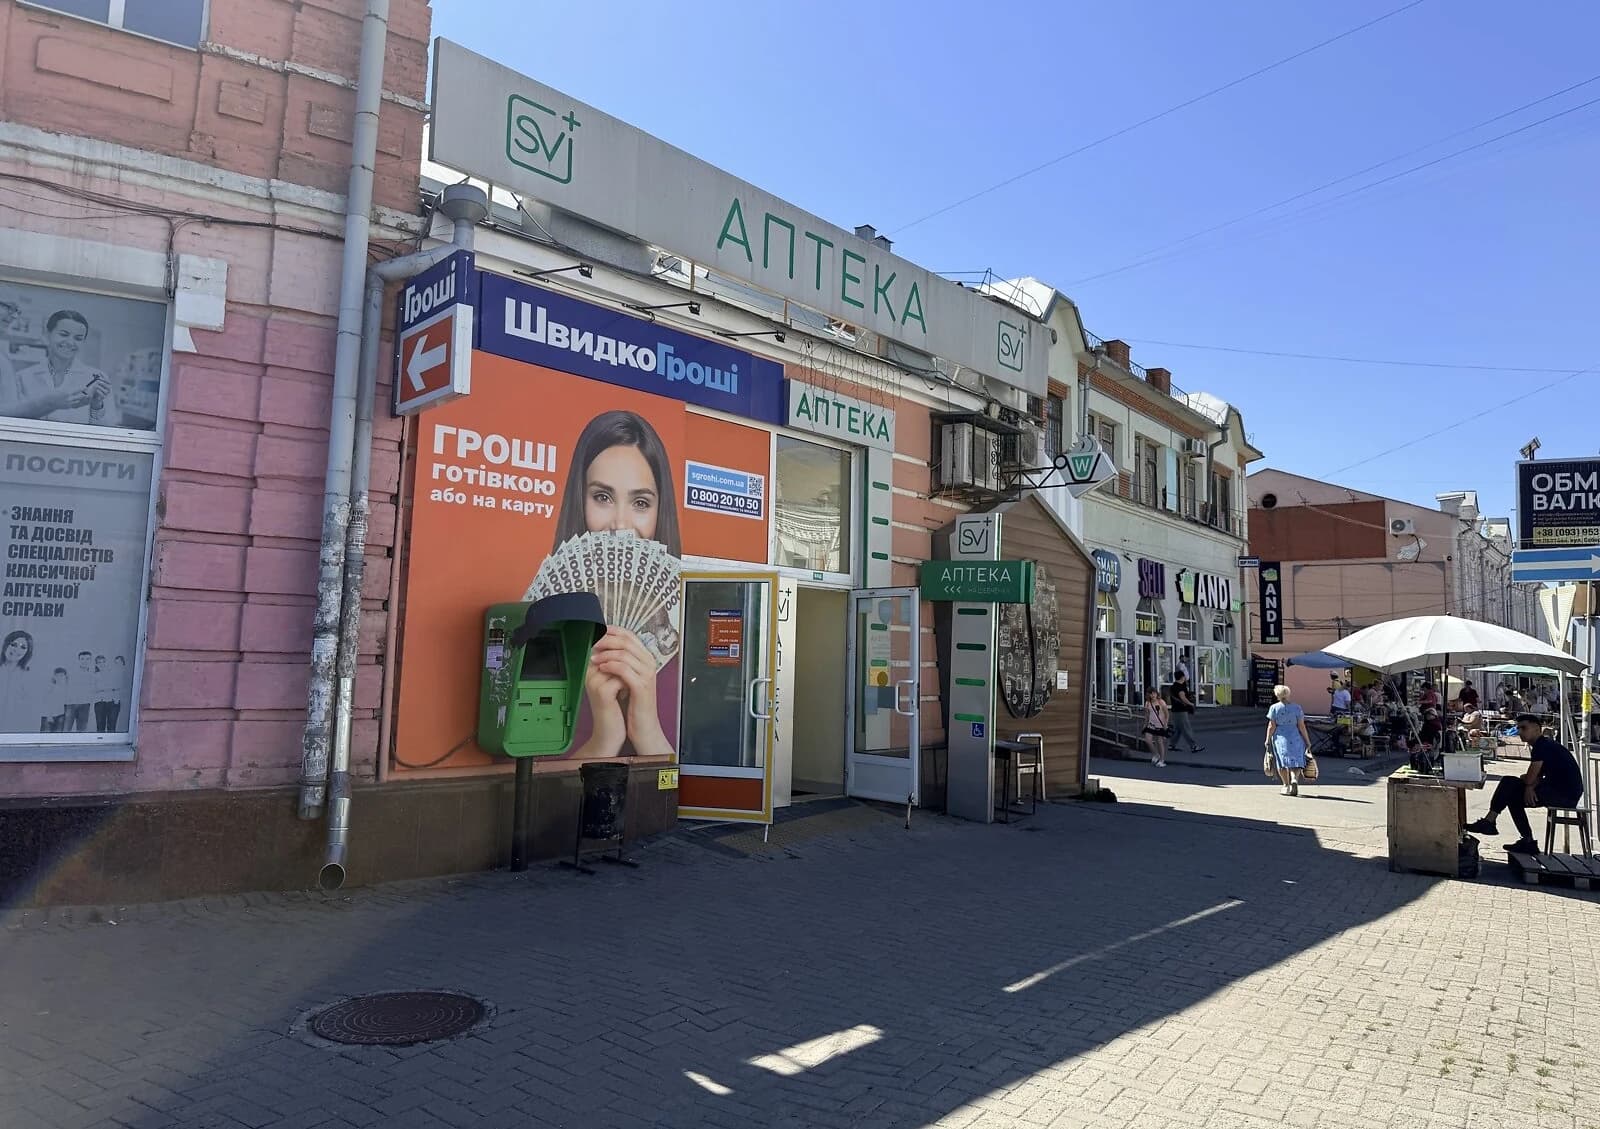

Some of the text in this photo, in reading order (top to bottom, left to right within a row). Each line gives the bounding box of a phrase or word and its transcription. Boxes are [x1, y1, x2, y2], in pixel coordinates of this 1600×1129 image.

[716, 198, 927, 334] АПТЕКА
[403, 260, 457, 324] Гроші
[504, 296, 739, 395] ШвидкоГроші
[796, 392, 890, 442] АПТЕКА
[433, 423, 556, 473] ГРОШІ
[5, 453, 136, 480] ПОСЛУГИ
[432, 463, 556, 496] готівкою
[691, 472, 745, 488] sgroshi.com.ua
[430, 488, 554, 519] або на карту
[691, 489, 699, 500] 0
[699, 490, 719, 503] 800
[720, 494, 733, 506] 20
[734, 496, 745, 508] 10
[746, 498, 759, 511] 50
[11, 505, 75, 524] ЗНАННЯ
[10, 525, 93, 546] ТА ДОСВІД
[8, 544, 114, 563] СПЕЦІАЛІСТІВ
[6, 563, 96, 581] КЛАСИЧНОЇ
[547, 569, 562, 592] 100
[558, 564, 573, 591] 100
[941, 567, 1011, 582] АПТЕКА
[3, 582, 80, 599] АПТЕЧНОЇ
[2, 601, 65, 617] СПРАВИ
[1265, 583, 1278, 636] ANDI
